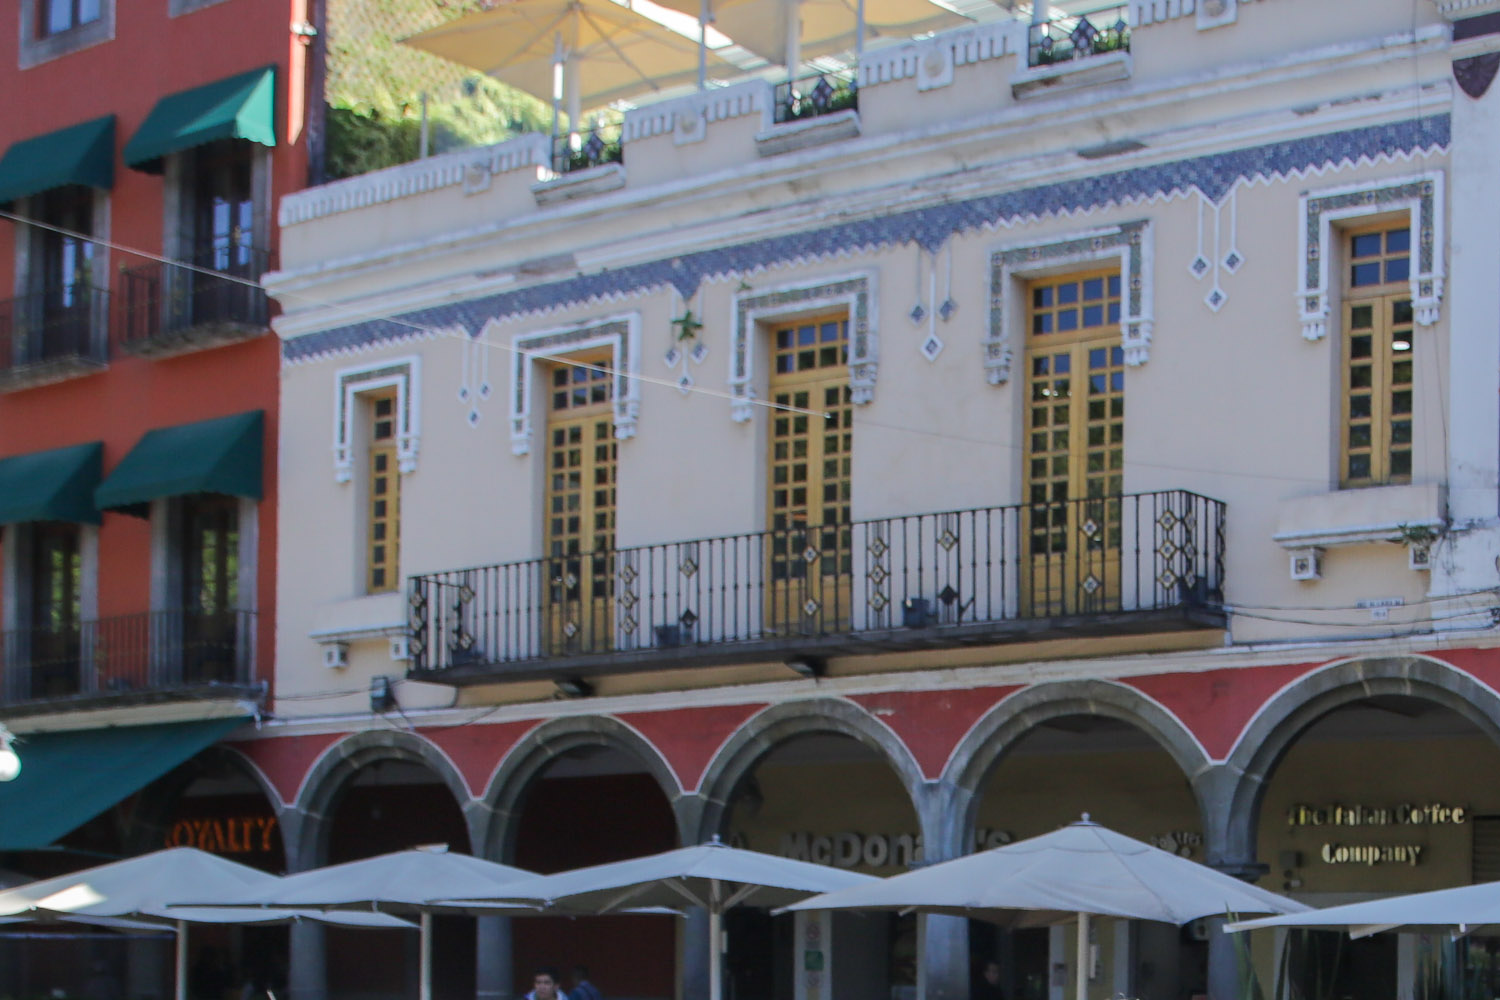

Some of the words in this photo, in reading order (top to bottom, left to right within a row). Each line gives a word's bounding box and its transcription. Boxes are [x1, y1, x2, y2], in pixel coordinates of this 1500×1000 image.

[1288, 805, 1325, 826] The
[1327, 804, 1394, 826] Italian
[1396, 803, 1466, 825] Coffee
[165, 817, 276, 851] OYALTY
[1321, 843, 1421, 866] Company
